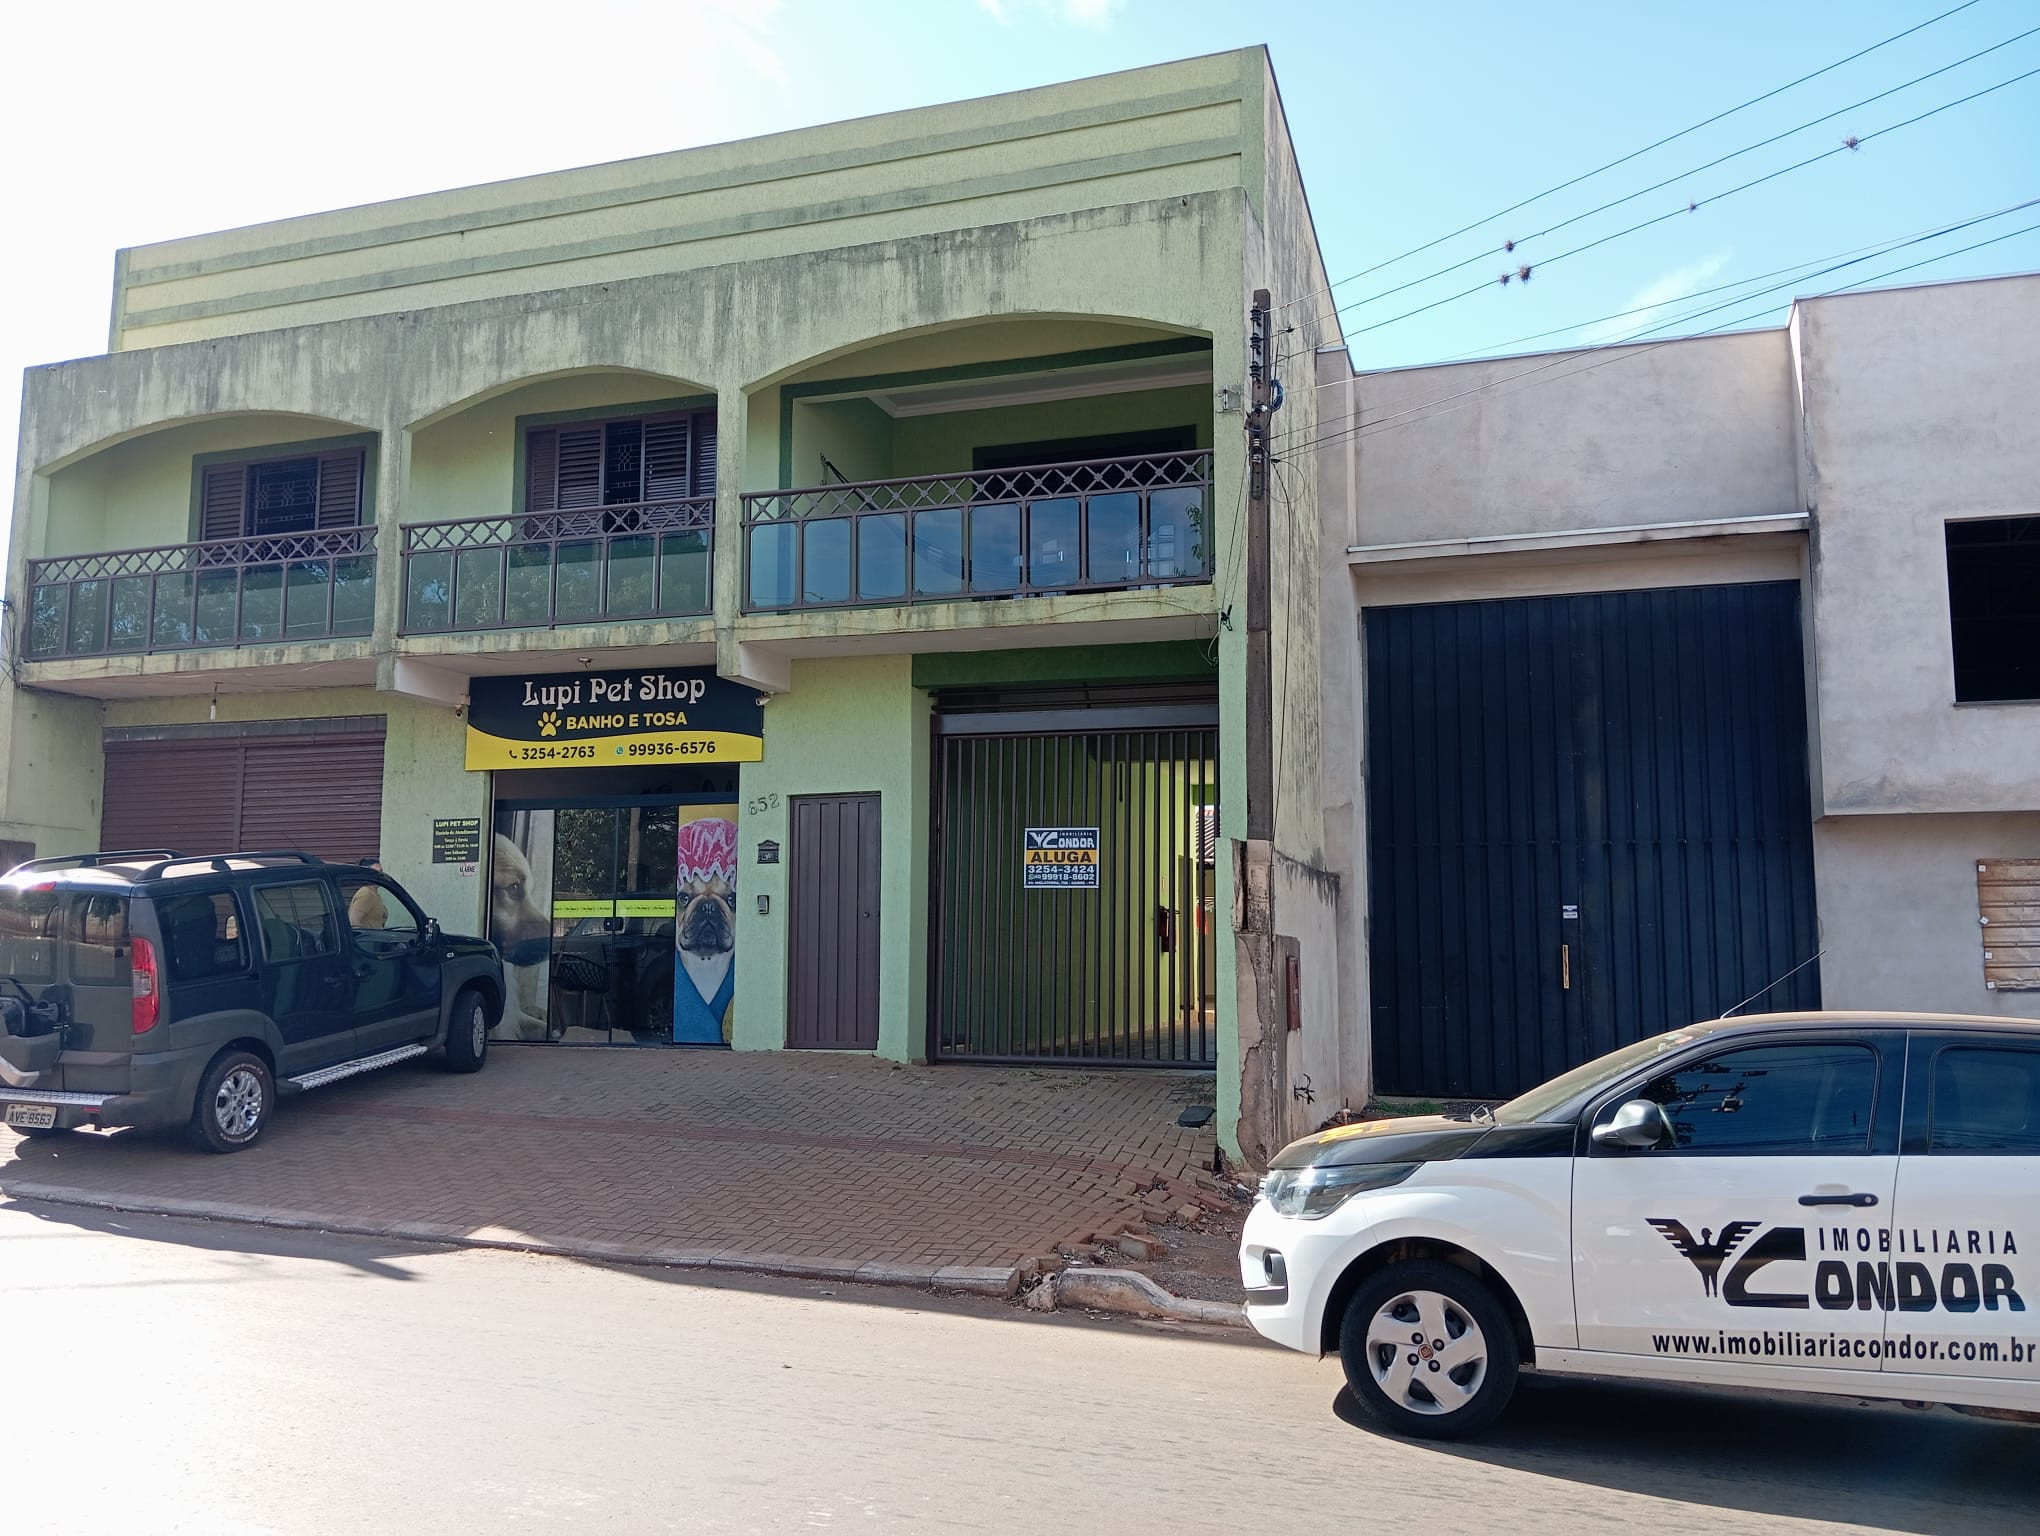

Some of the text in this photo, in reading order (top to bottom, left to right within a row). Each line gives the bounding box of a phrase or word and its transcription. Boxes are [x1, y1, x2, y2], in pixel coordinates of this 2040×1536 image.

[522, 675, 706, 710] Lupi Pet Shop
[566, 711, 688, 730] BANHO E TOSA
[521, 741, 716, 760] 3254-2763 99936-6576
[748, 793, 780, 816] 652
[1030, 851, 1092, 863] ALUGA
[1028, 865, 1094, 873] 3254-3424
[1818, 1226, 2018, 1255] IMOBILIARIA
[1652, 1330, 2038, 1364] www.imobiliariacondor.com.br
